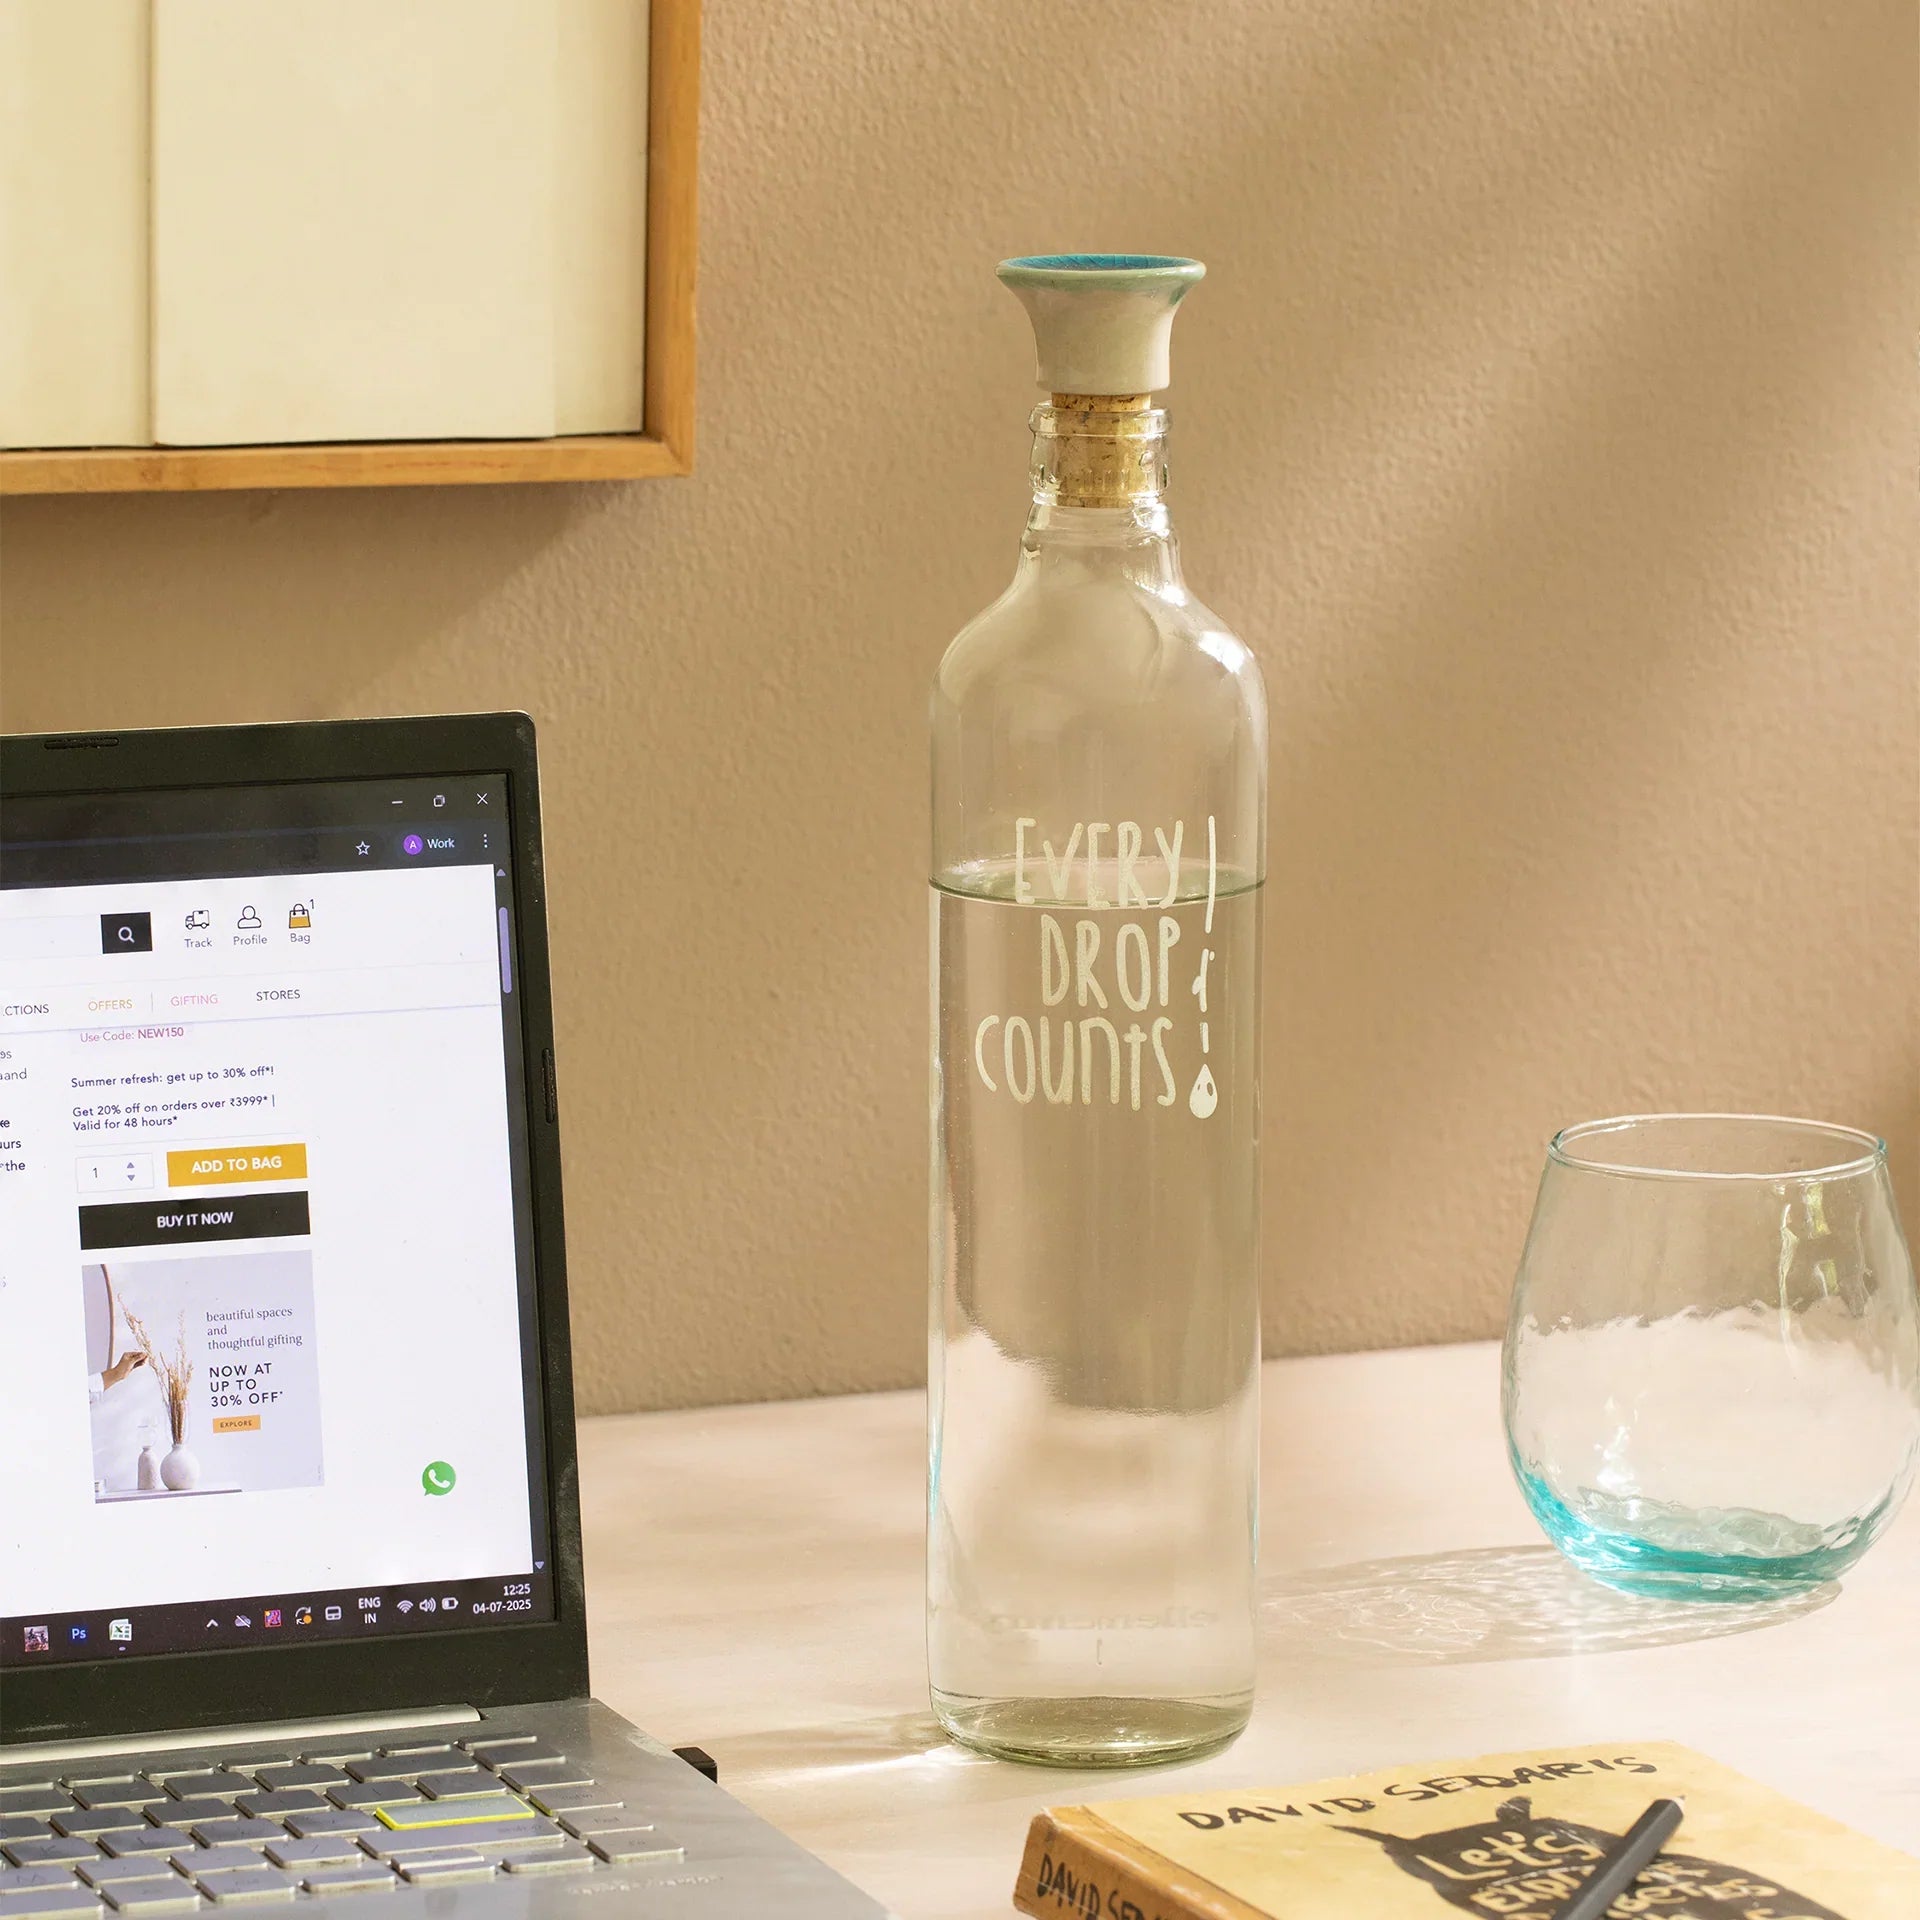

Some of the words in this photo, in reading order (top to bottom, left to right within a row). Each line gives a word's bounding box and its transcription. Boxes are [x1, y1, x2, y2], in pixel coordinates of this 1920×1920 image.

[427, 838, 455, 849] Work
[1015, 816, 1184, 909] EVERY
[309, 899, 315, 910] 1
[184, 938, 213, 949] Track
[233, 934, 268, 946] Profile
[290, 932, 311, 944] Bag
[1040, 914, 1181, 1012] DROP
[170, 994, 218, 1007] GIFTING
[256, 989, 301, 1001] STORES
[2, 1004, 50, 1017] CTIONS
[88, 998, 133, 1012] OFFERS
[80, 1032, 100, 1043] Use
[102, 1029, 135, 1041] Code:
[137, 1027, 184, 1039] NEW150
[71, 1075, 116, 1088] Summer
[120, 1072, 163, 1085] refresh:
[166, 1073, 186, 1084] get
[189, 1072, 204, 1083] up
[207, 1070, 219, 1080] to
[223, 1067, 246, 1078] 30%
[72, 1107, 94, 1117] Get
[97, 1104, 121, 1115] 20%
[125, 1102, 140, 1113] off
[144, 1104, 158, 1112] on
[162, 1100, 198, 1111] orders
[201, 1100, 226, 1109] over
[73, 1120, 101, 1131] Valid
[104, 1118, 121, 1129] for
[124, 1117, 138, 1128] 48
[191, 1158, 223, 1174] ADD
[226, 1158, 248, 1171] TO
[252, 1156, 282, 1169] BAG
[93, 1167, 98, 1178] 1
[157, 1214, 184, 1228] BUY
[186, 1213, 198, 1226] IT
[201, 1211, 234, 1224] NOW
[206, 1308, 254, 1322] beautiful
[256, 1308, 293, 1320] spaces
[207, 1325, 227, 1336] and
[208, 1336, 265, 1351] thoughtful
[267, 1334, 303, 1349] gifting
[209, 1364, 247, 1378] NOW
[254, 1363, 272, 1374] AT
[210, 1380, 229, 1392] UP
[236, 1378, 257, 1390] TO
[211, 1394, 242, 1407] 30%
[220, 1420, 252, 1428] EXPLORE
[503, 1583, 531, 1596] 12:25
[358, 1597, 381, 1609] ENG
[473, 1599, 532, 1614] 04-07-2025
[364, 1613, 377, 1624] IN
[72, 1628, 86, 1639] Ps
[1178, 1796, 1376, 1830] DAVID
[1384, 1756, 1657, 1801] SEDARIS
[1415, 1831, 1607, 1881] Let's
